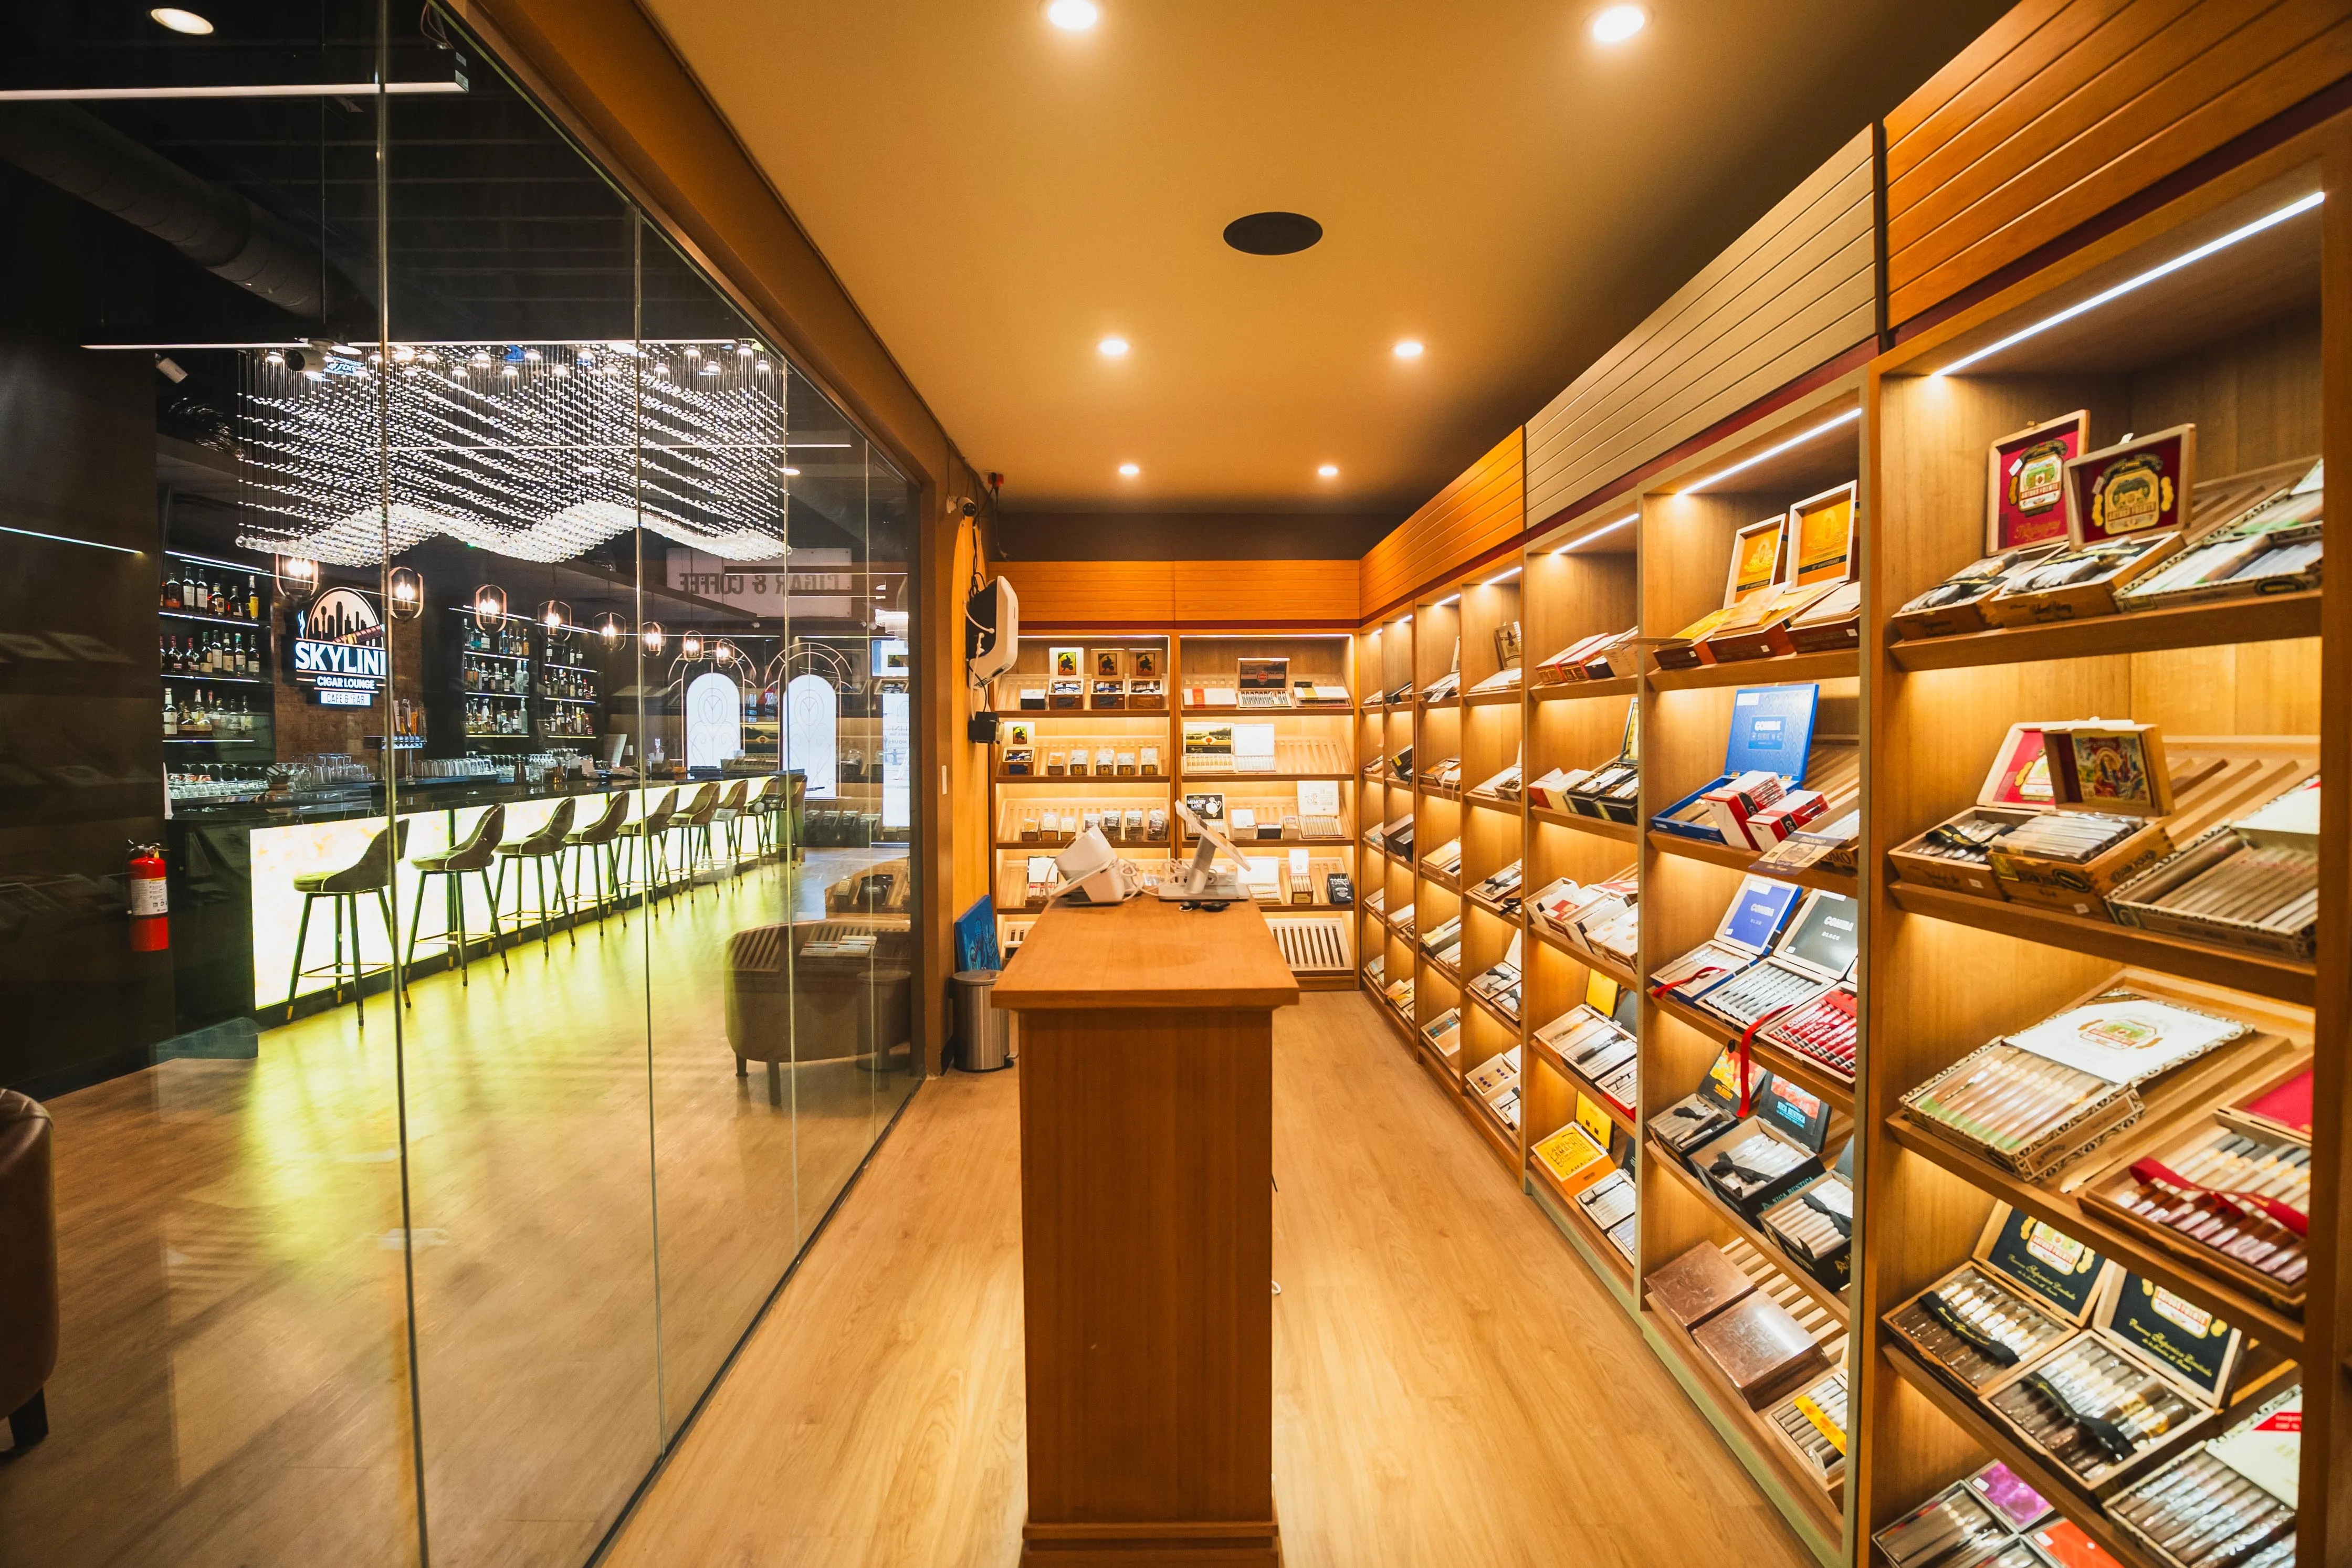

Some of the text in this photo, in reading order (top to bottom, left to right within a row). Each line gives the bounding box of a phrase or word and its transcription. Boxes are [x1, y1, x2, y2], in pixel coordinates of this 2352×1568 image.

[317, 676, 375, 689] CIGAR LOUNGE
[327, 693, 343, 703] CAFE
